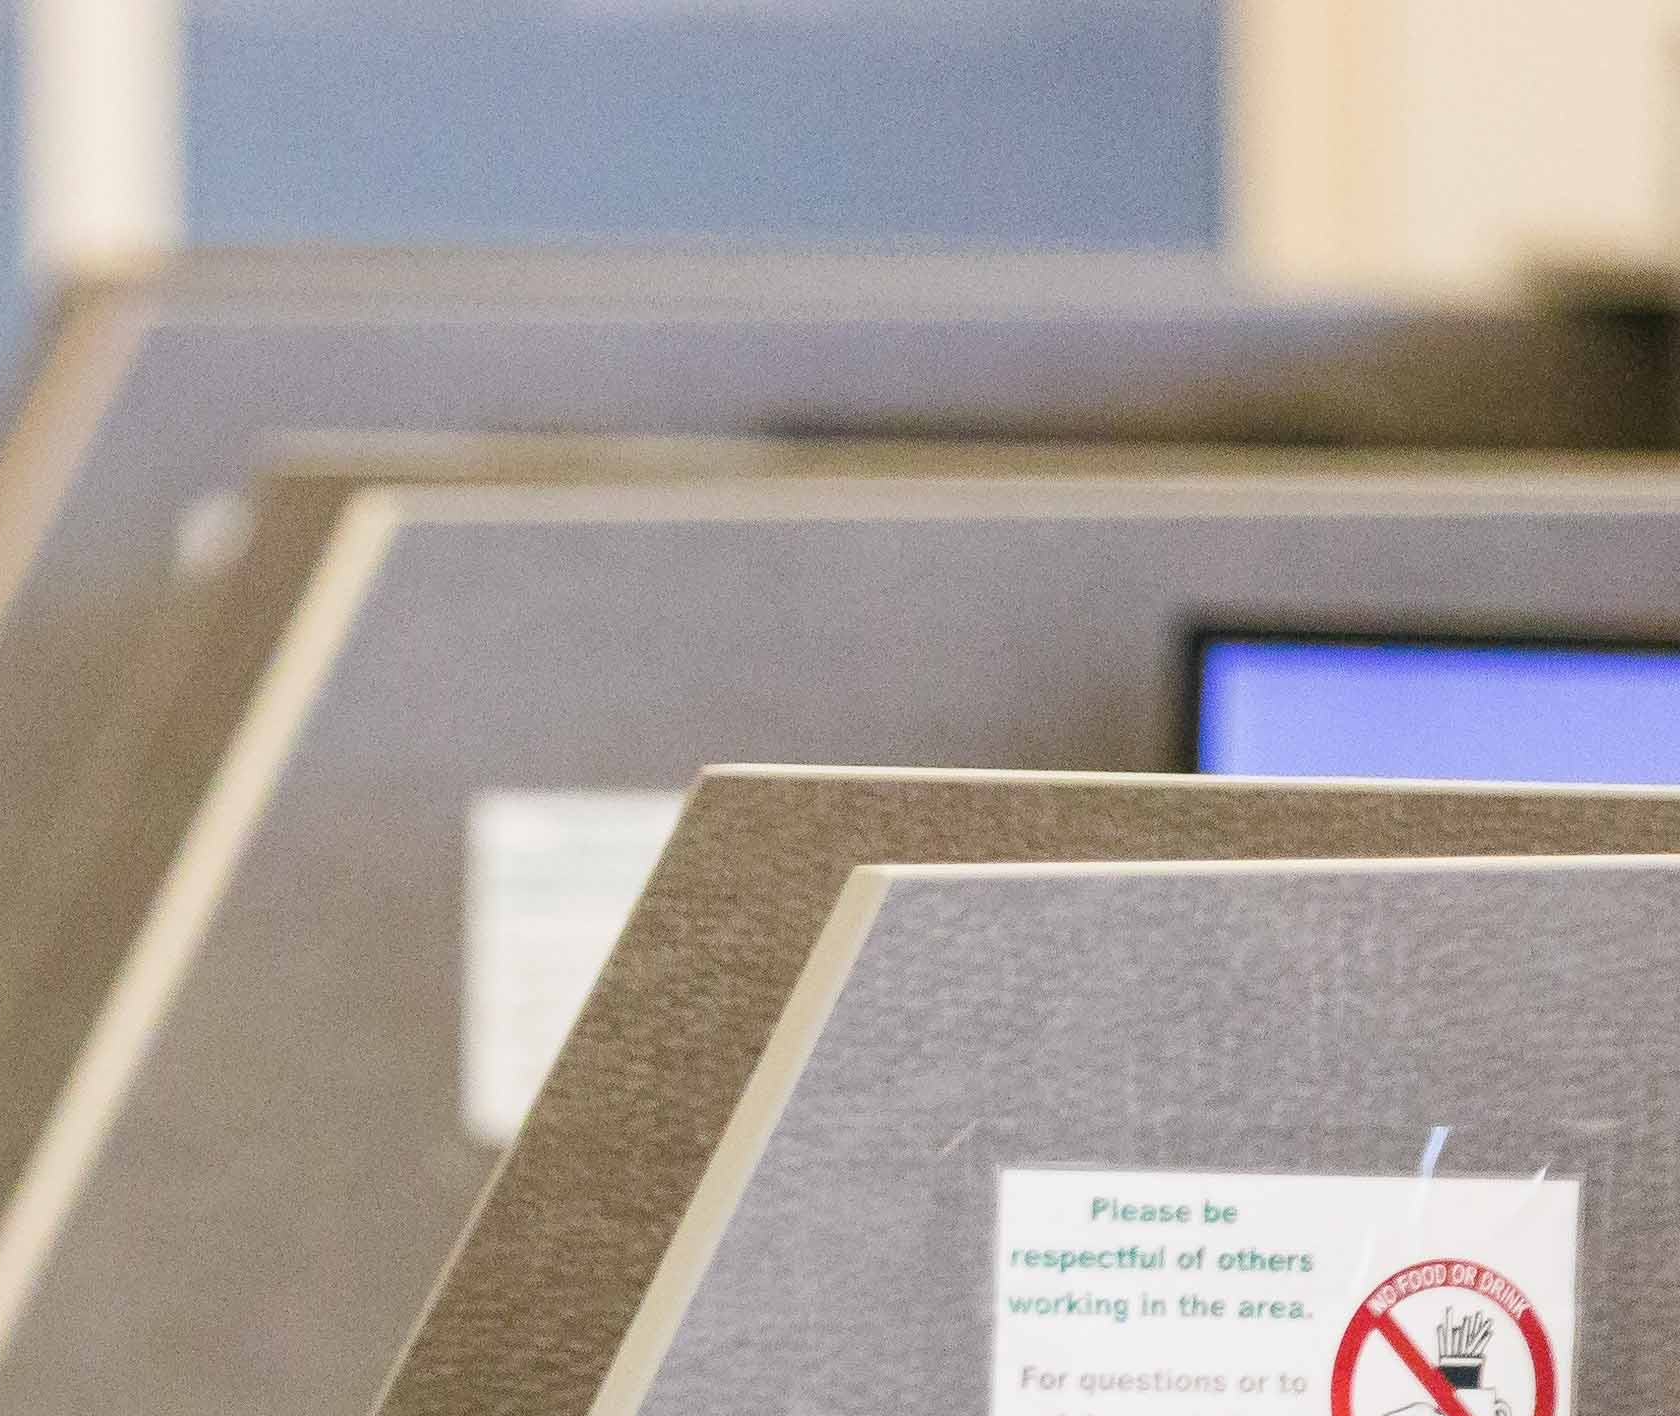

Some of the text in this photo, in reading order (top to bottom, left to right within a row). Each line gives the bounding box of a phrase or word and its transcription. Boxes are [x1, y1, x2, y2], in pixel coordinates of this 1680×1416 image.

[1091, 1197, 1238, 1223] Please be
[1010, 1246, 1315, 1273] respectful of others
[1368, 1263, 1530, 1319] NO FOOD OR DRINK
[1008, 1293, 1313, 1322] working in the area.
[1020, 1366, 1309, 1398] For questions or to
